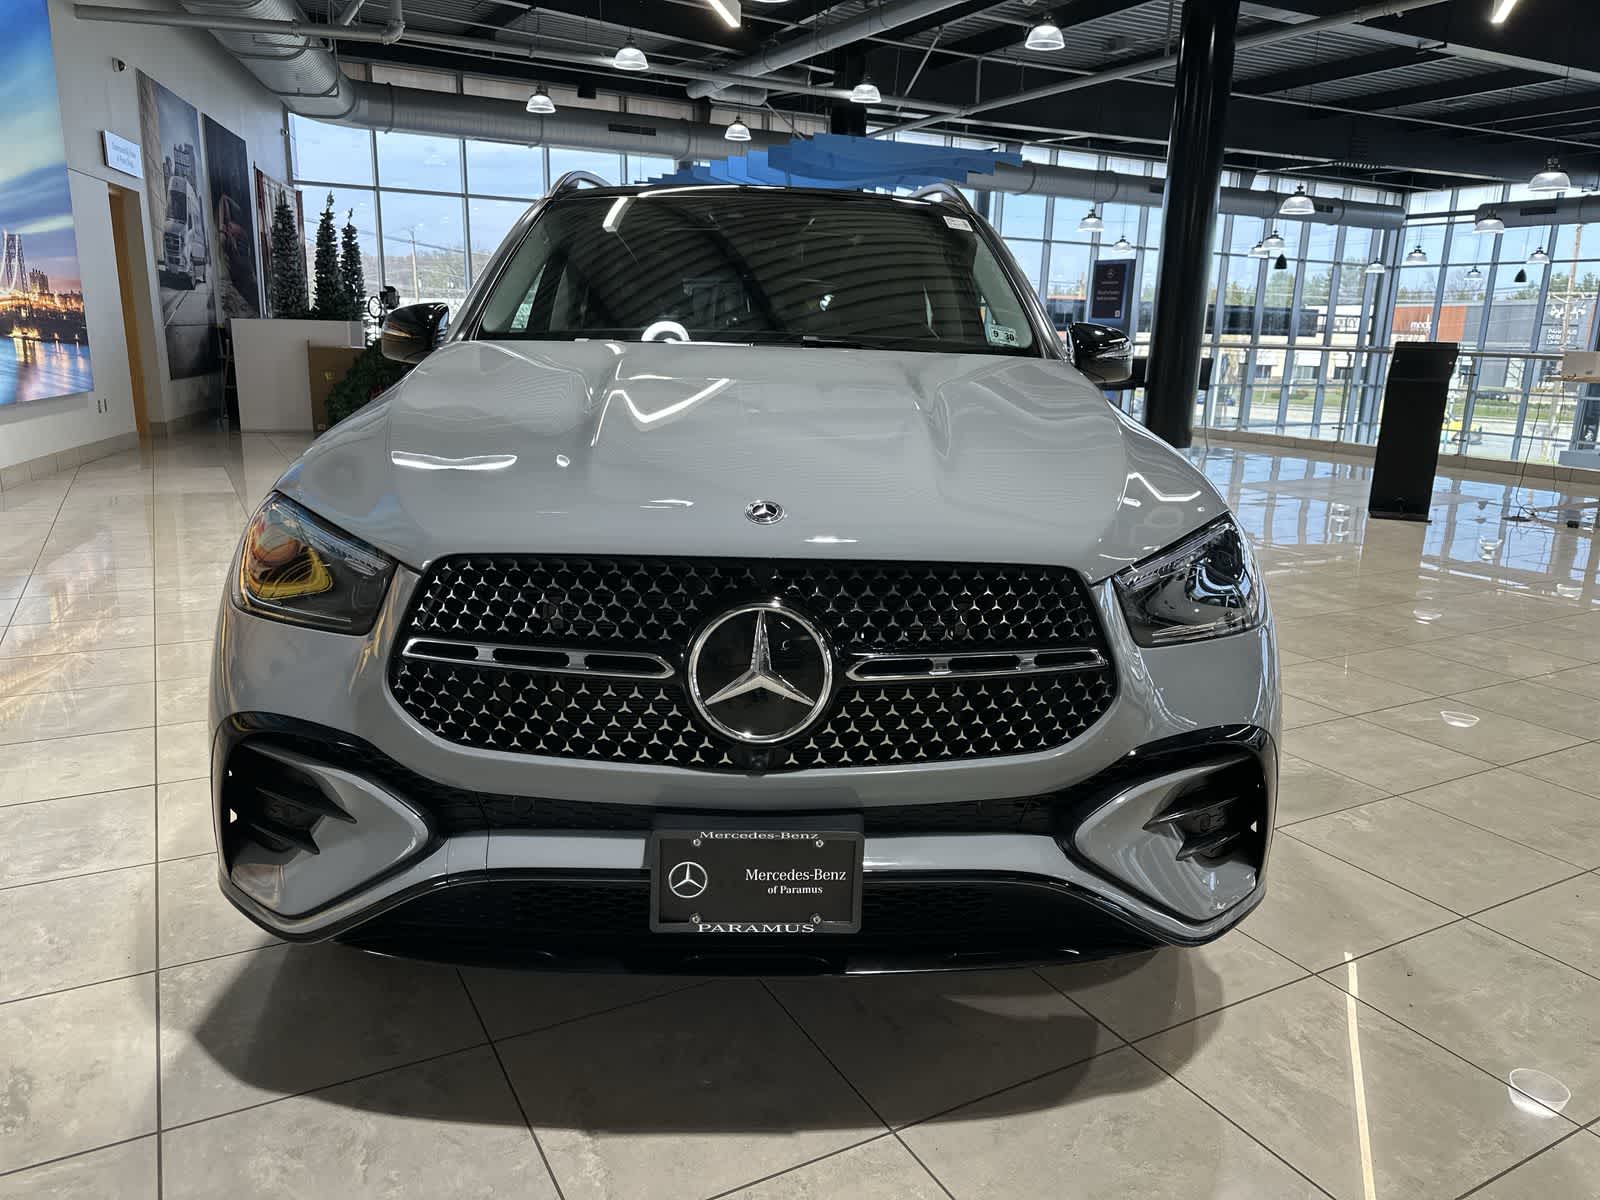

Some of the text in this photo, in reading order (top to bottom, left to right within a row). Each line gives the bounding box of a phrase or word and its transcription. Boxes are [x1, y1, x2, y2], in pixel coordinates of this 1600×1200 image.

[699, 831, 820, 840] Mercedes-Benz
[745, 868, 847, 882] Mercedes-Benz
[767, 885, 823, 895] of Paramus
[697, 923, 815, 933] PARAMUS
